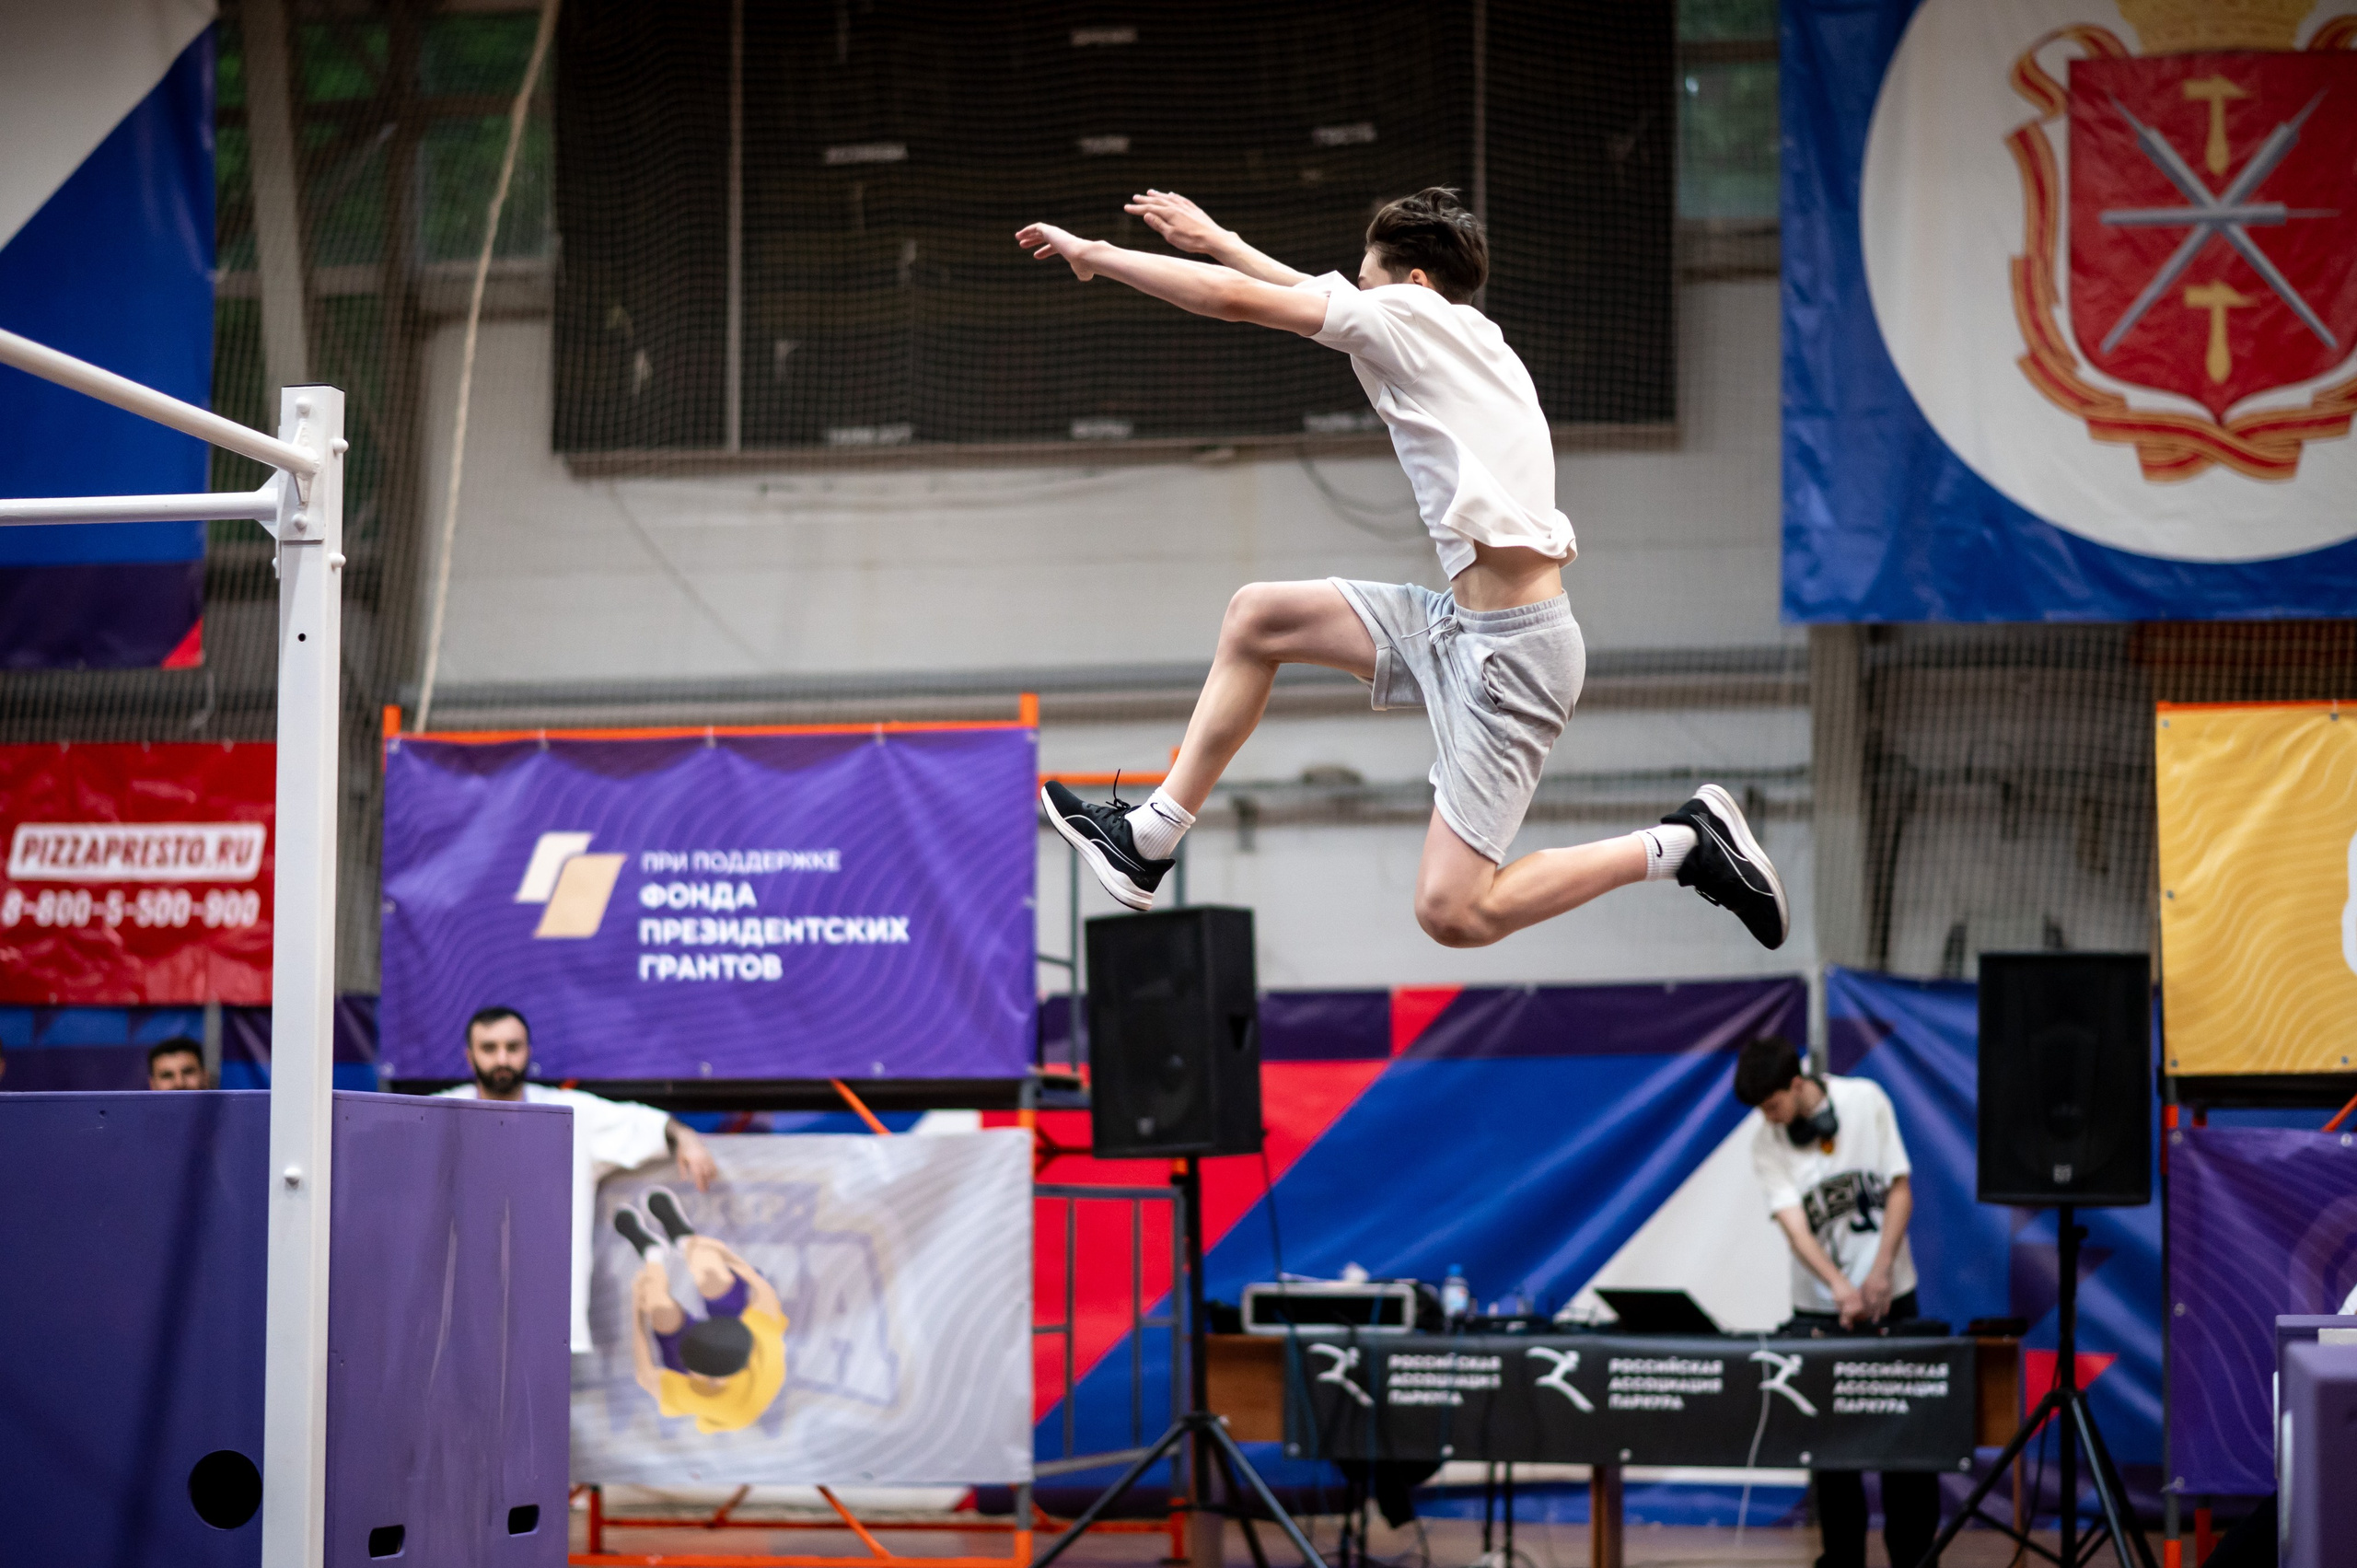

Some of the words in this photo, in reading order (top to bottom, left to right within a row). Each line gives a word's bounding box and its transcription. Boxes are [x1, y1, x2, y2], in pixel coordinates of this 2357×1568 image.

[20, 834, 255, 867] PIZZAPRESTO.RU
[642, 851, 688, 873] ПРИ
[693, 850, 841, 874] ПОДДЕРЖКЕ
[640, 882, 757, 911] ФОНДА
[1, 888, 261, 928] 8-800-5-500-900
[640, 917, 910, 947] ПРЕЗИДЕНТСКИХ
[640, 953, 784, 981] ГРАНТОВ
[1608, 1357, 1722, 1374] РОССИЙСКАЯ
[1833, 1360, 1948, 1377] РОССИЙСКАЯ
[1608, 1376, 1722, 1393] АССОЦИАЦИЯ
[1833, 1380, 1948, 1397] АССОЦИАЦИЯ
[1608, 1394, 1683, 1410] ПАРКУРА
[1833, 1398, 1909, 1413] ПАРКУРА
